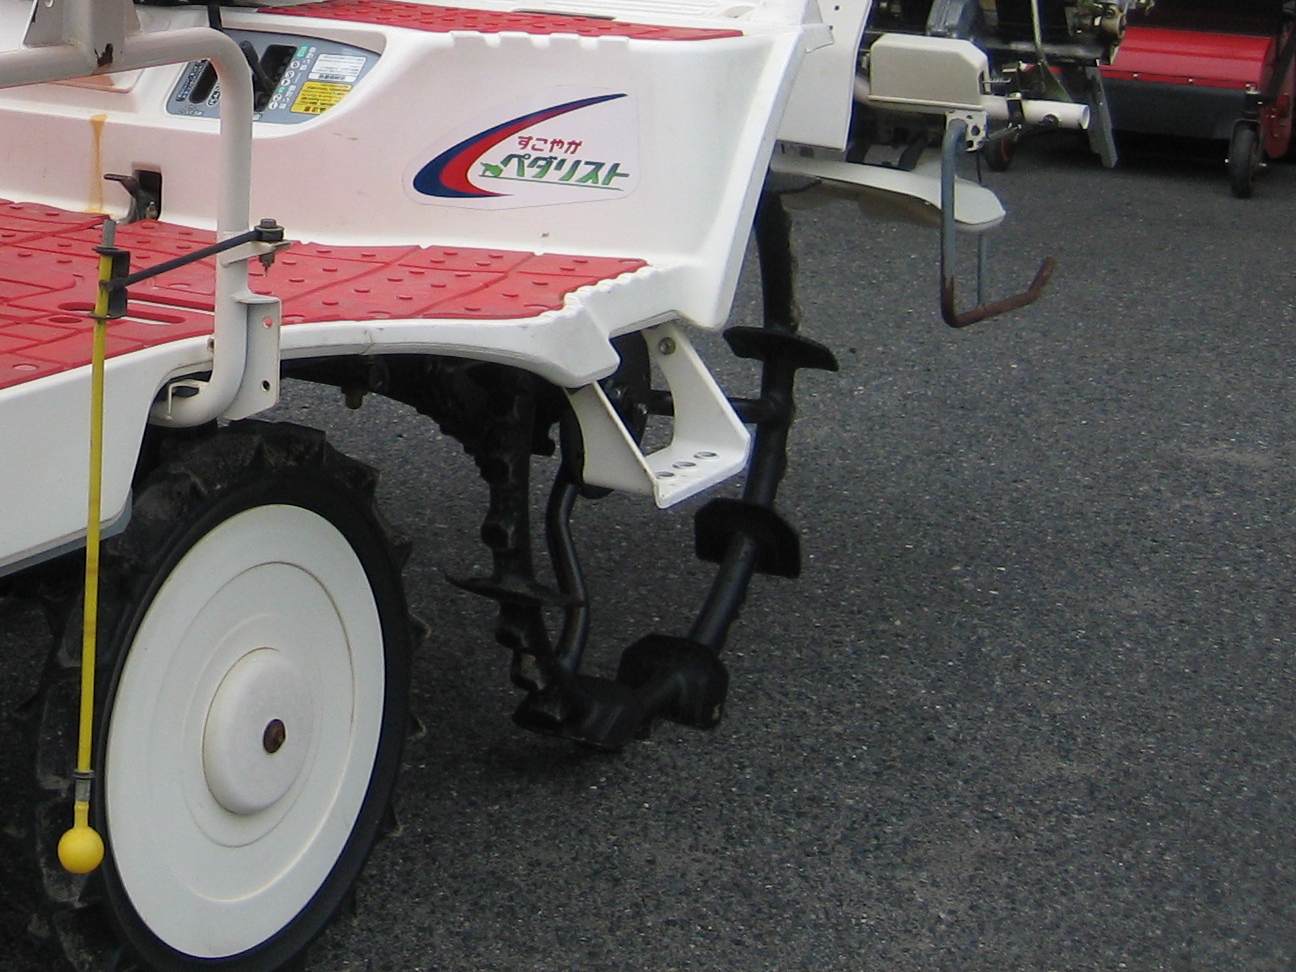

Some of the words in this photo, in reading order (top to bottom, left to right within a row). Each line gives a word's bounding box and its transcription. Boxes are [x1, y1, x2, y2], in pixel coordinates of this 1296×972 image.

[517, 135, 583, 154] すこやか
[501, 153, 630, 185] ペダリスト
